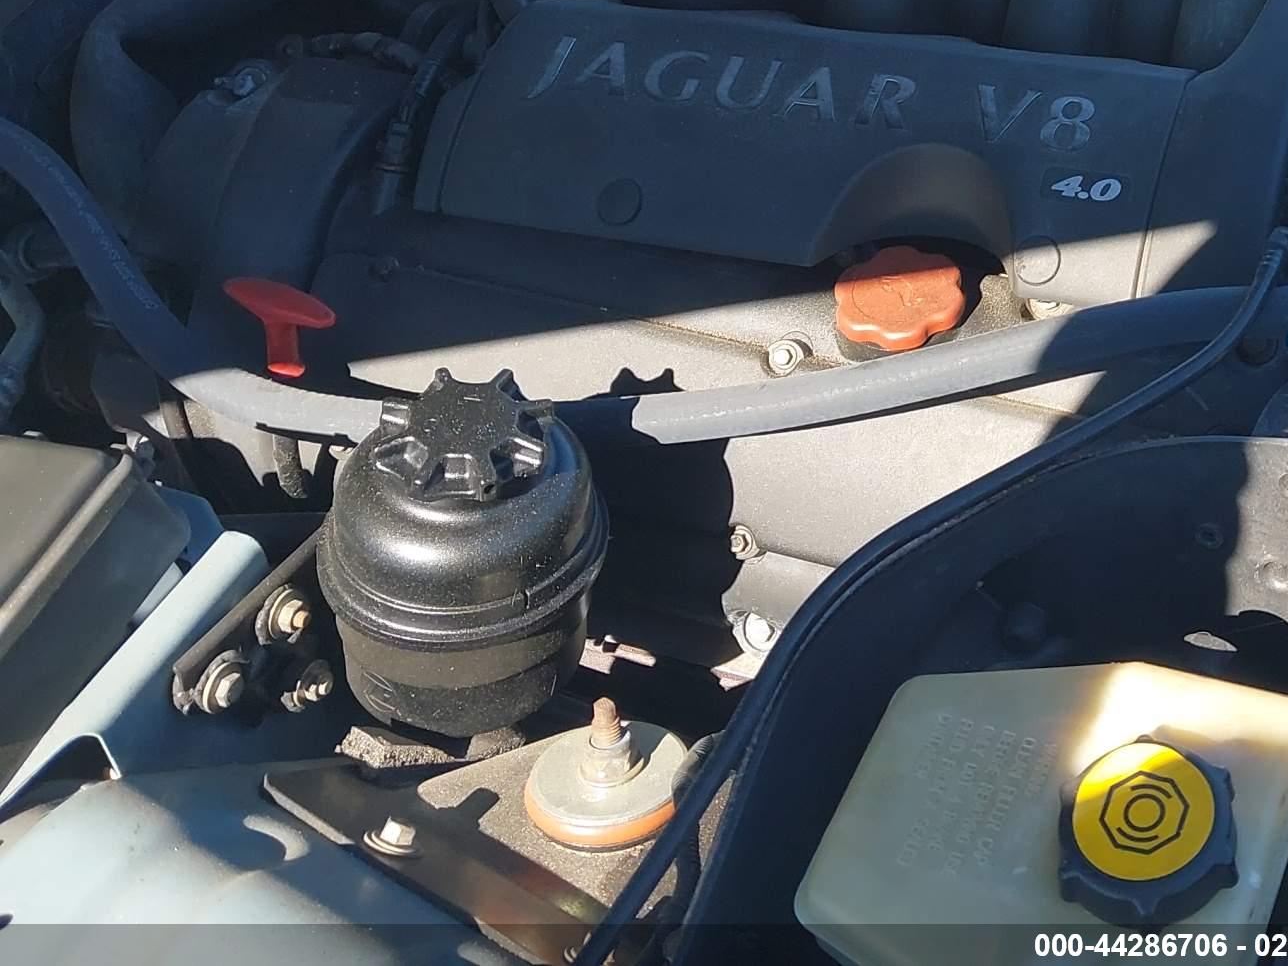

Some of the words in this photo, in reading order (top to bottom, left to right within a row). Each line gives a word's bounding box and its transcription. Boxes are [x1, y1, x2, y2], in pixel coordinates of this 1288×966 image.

[527, 36, 916, 130] JAGUAR
[978, 84, 1097, 152] V8
[1050, 175, 1123, 202] 4.0
